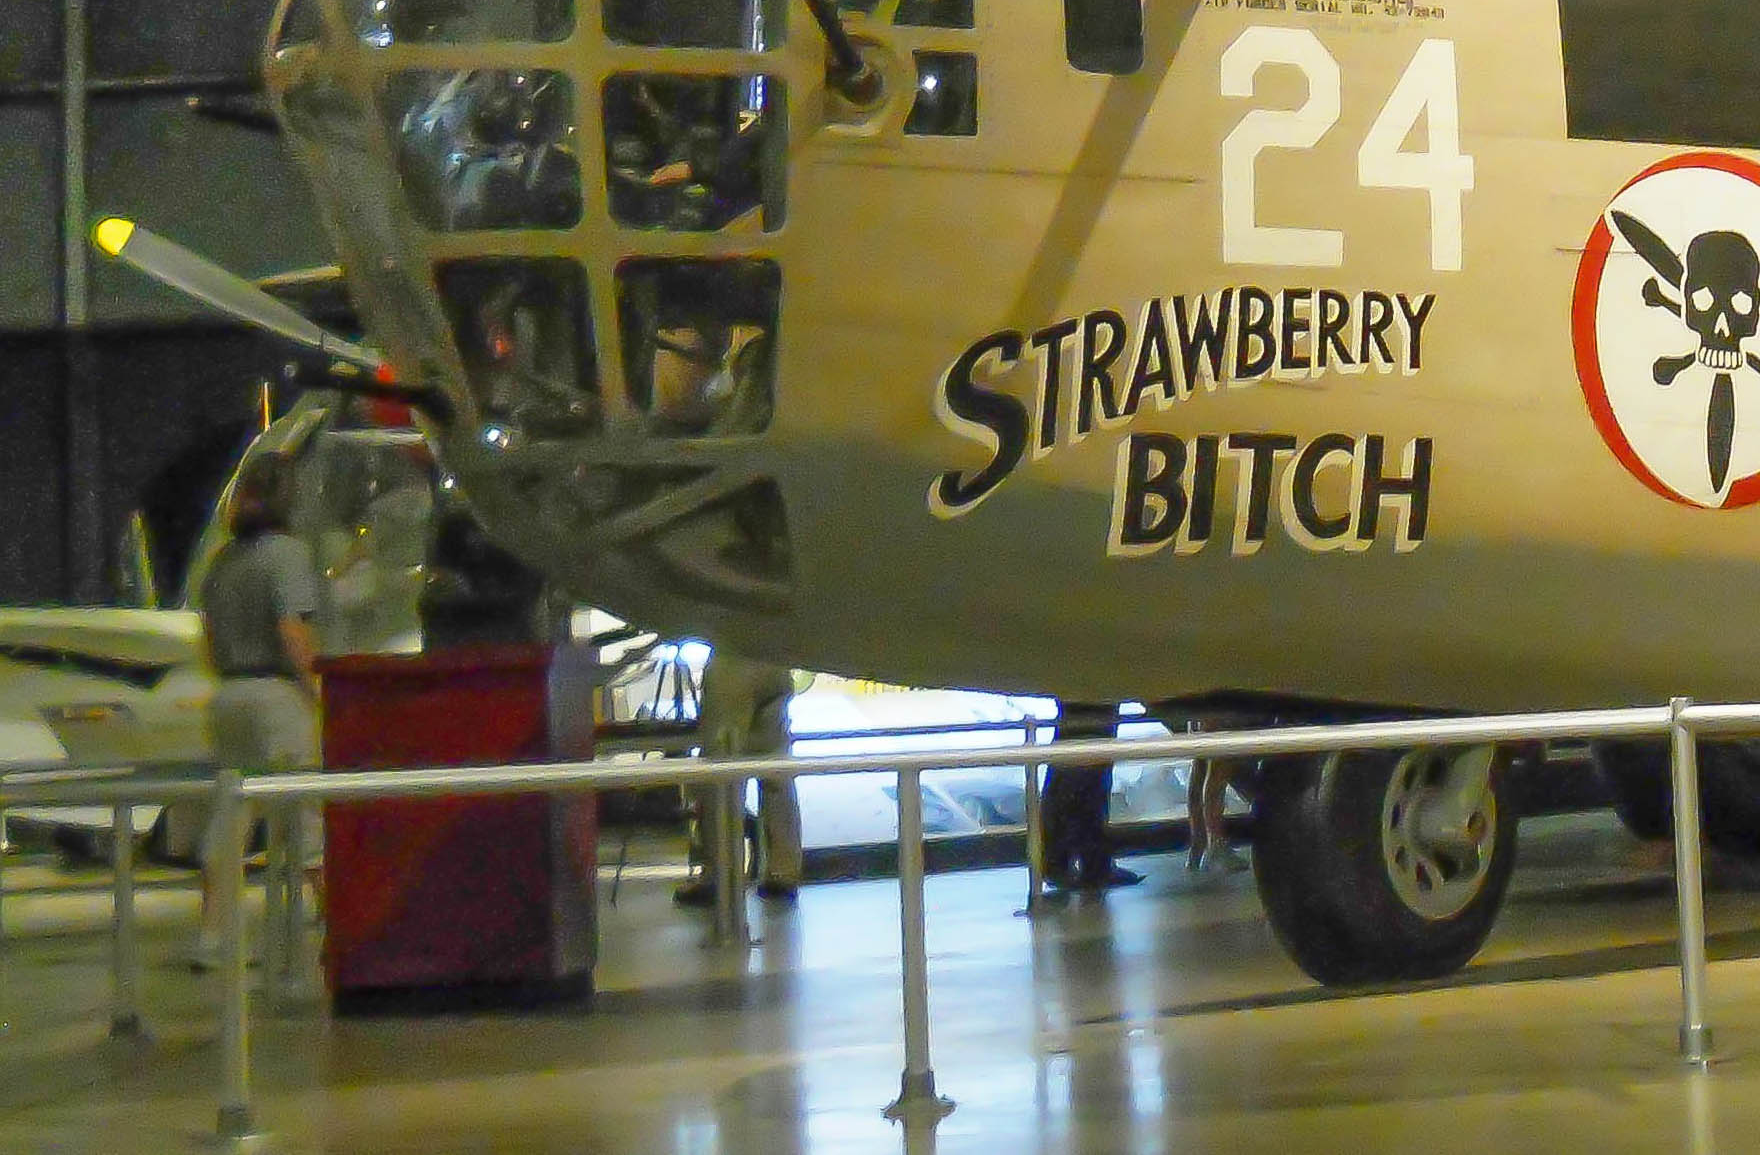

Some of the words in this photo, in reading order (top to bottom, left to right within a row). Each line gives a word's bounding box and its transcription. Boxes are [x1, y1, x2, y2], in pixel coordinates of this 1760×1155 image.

[1219, 25, 1475, 272] 24
[928, 286, 1439, 518] STRAWBERRY
[1107, 432, 1433, 556] BITCH
